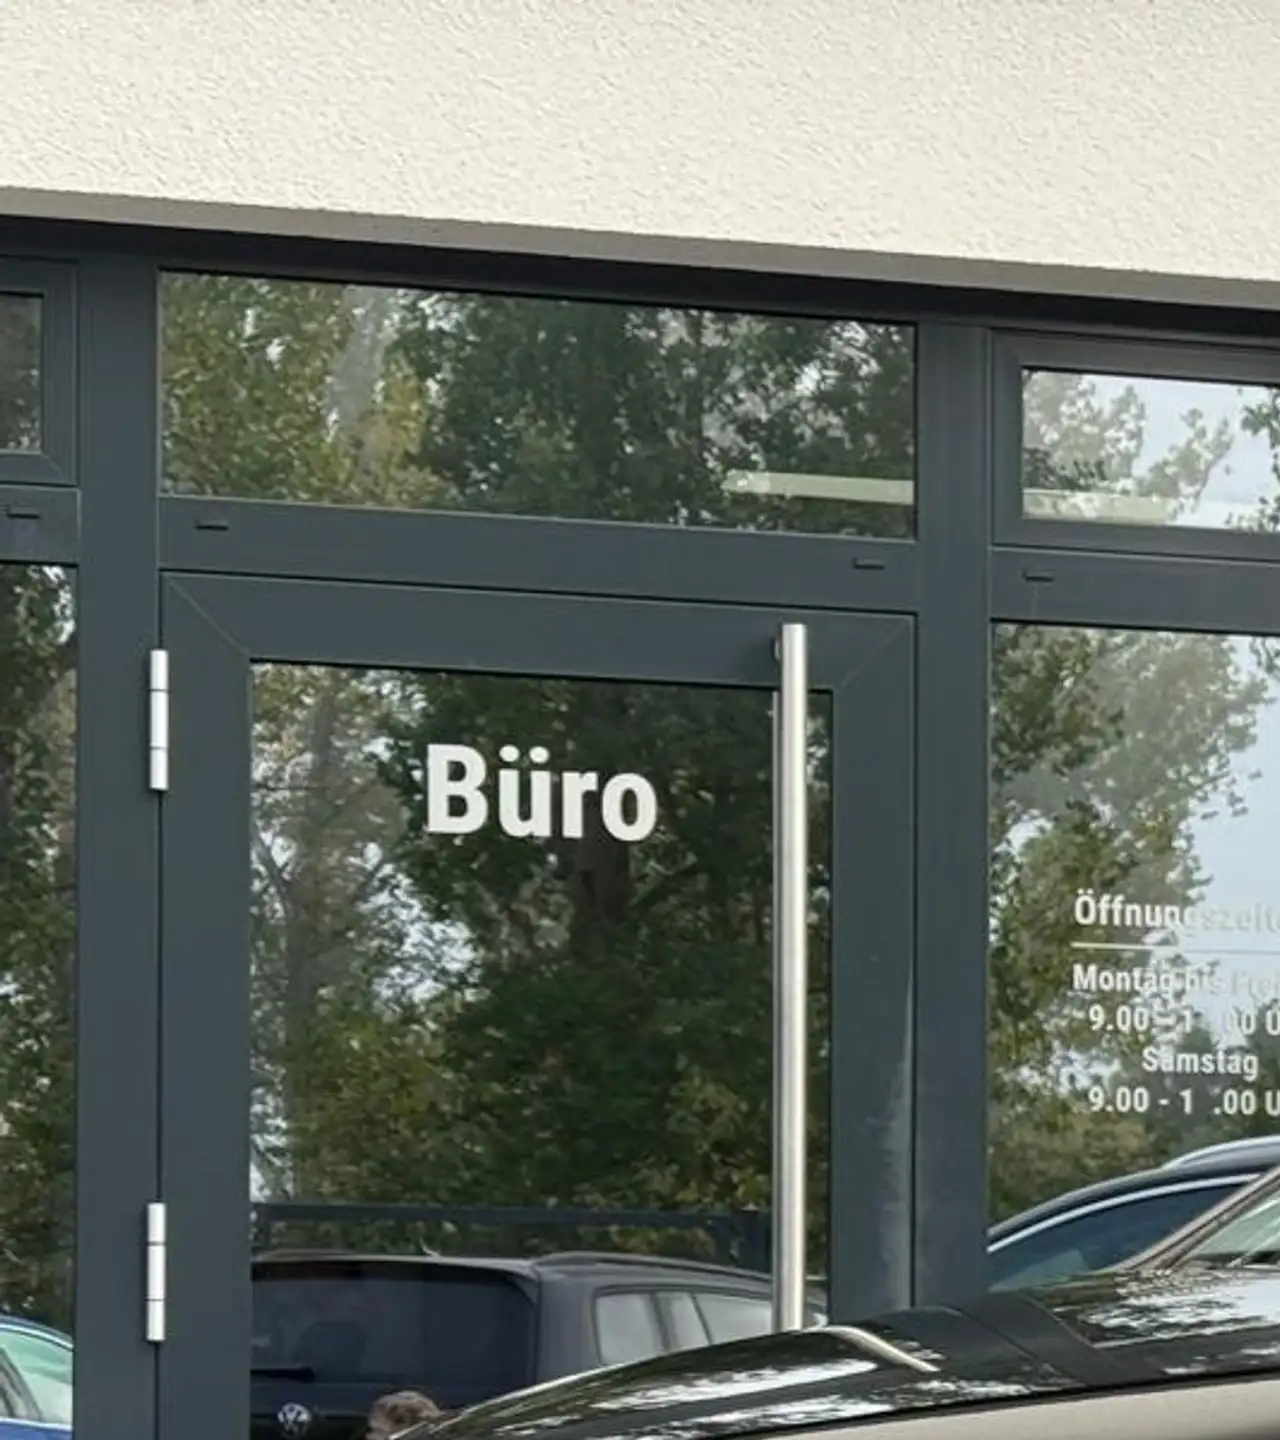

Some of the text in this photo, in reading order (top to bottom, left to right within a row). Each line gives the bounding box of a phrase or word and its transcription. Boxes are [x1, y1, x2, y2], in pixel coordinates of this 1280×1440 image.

[427, 743, 657, 841] Büro
[1072, 963, 1172, 998] Montag
[1089, 1003, 1149, 1036] 9.00
[1142, 1046, 1259, 1082] Samstag
[1088, 1086, 1149, 1114] 9.00
